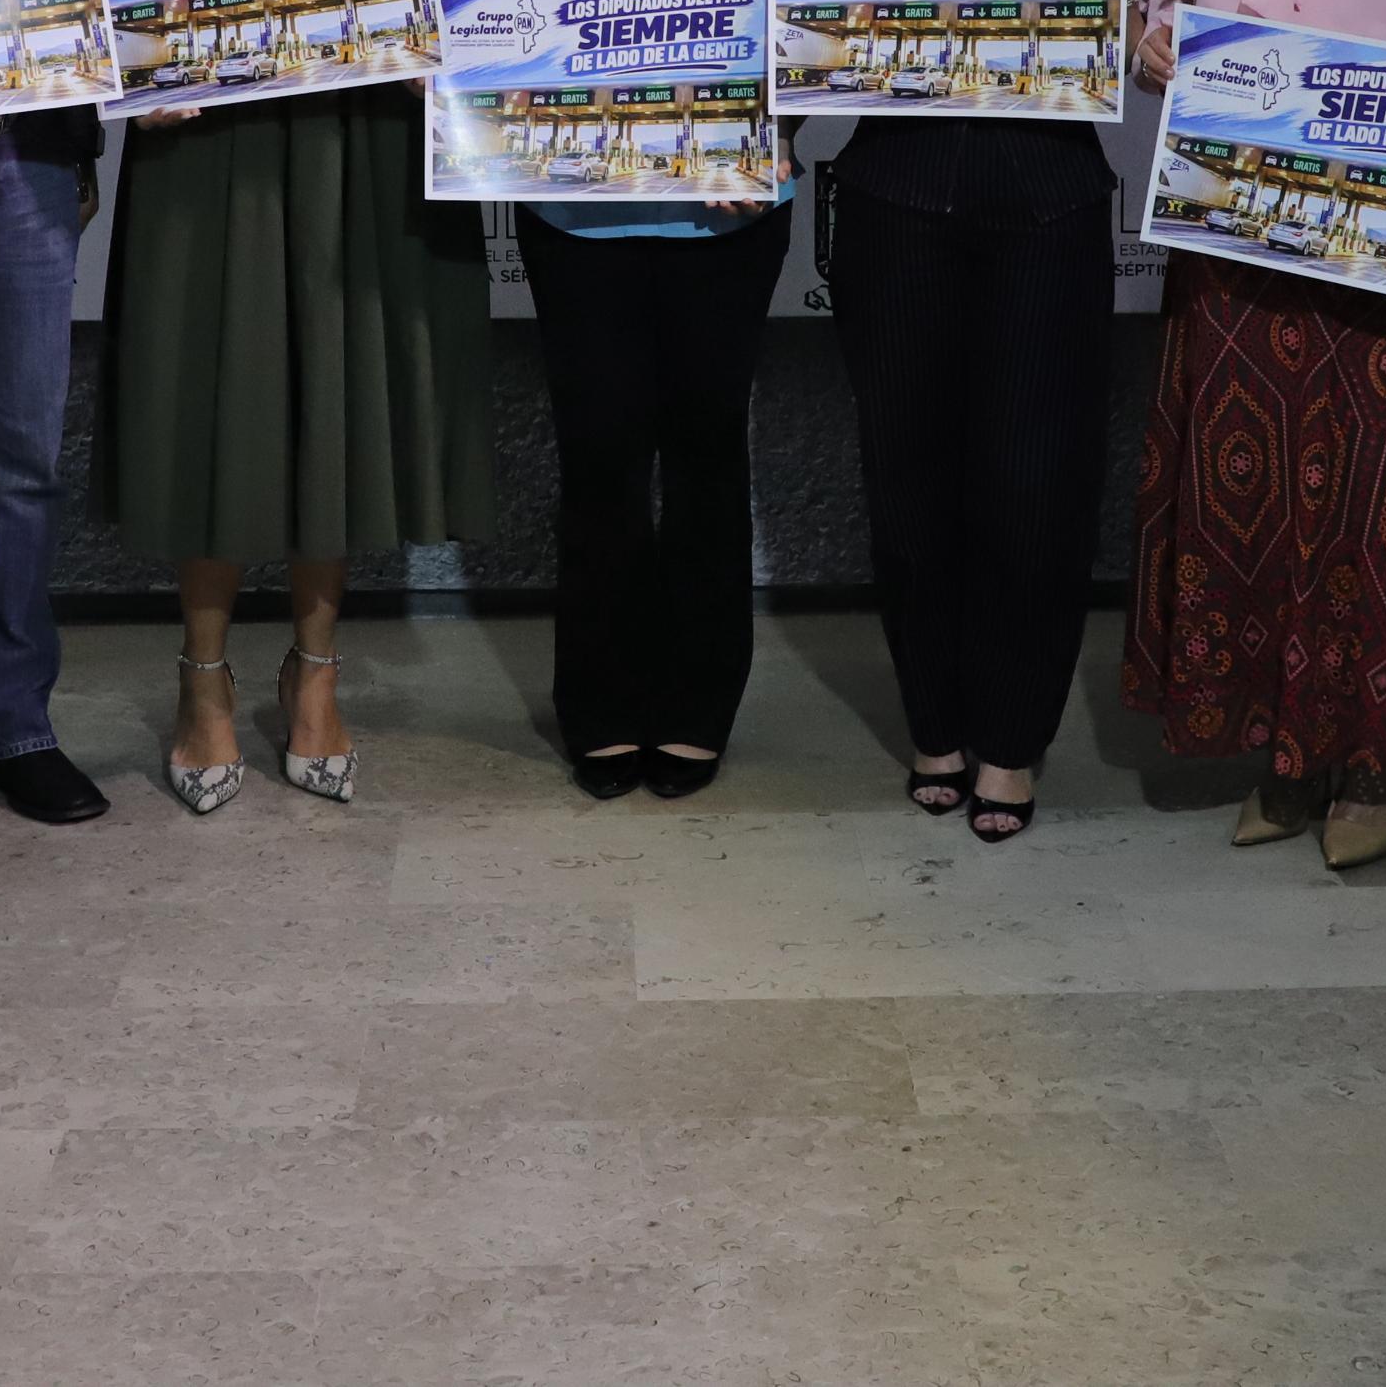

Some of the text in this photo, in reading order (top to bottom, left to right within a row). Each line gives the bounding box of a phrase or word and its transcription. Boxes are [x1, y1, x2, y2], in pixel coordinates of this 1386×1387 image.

[132, 6, 156, 19] GRATIS
[815, 8, 840, 20] GRATIS
[905, 7, 932, 18] GRATIS
[991, 6, 1016, 18] GRATIS
[1074, 5, 1103, 17] GRATIS
